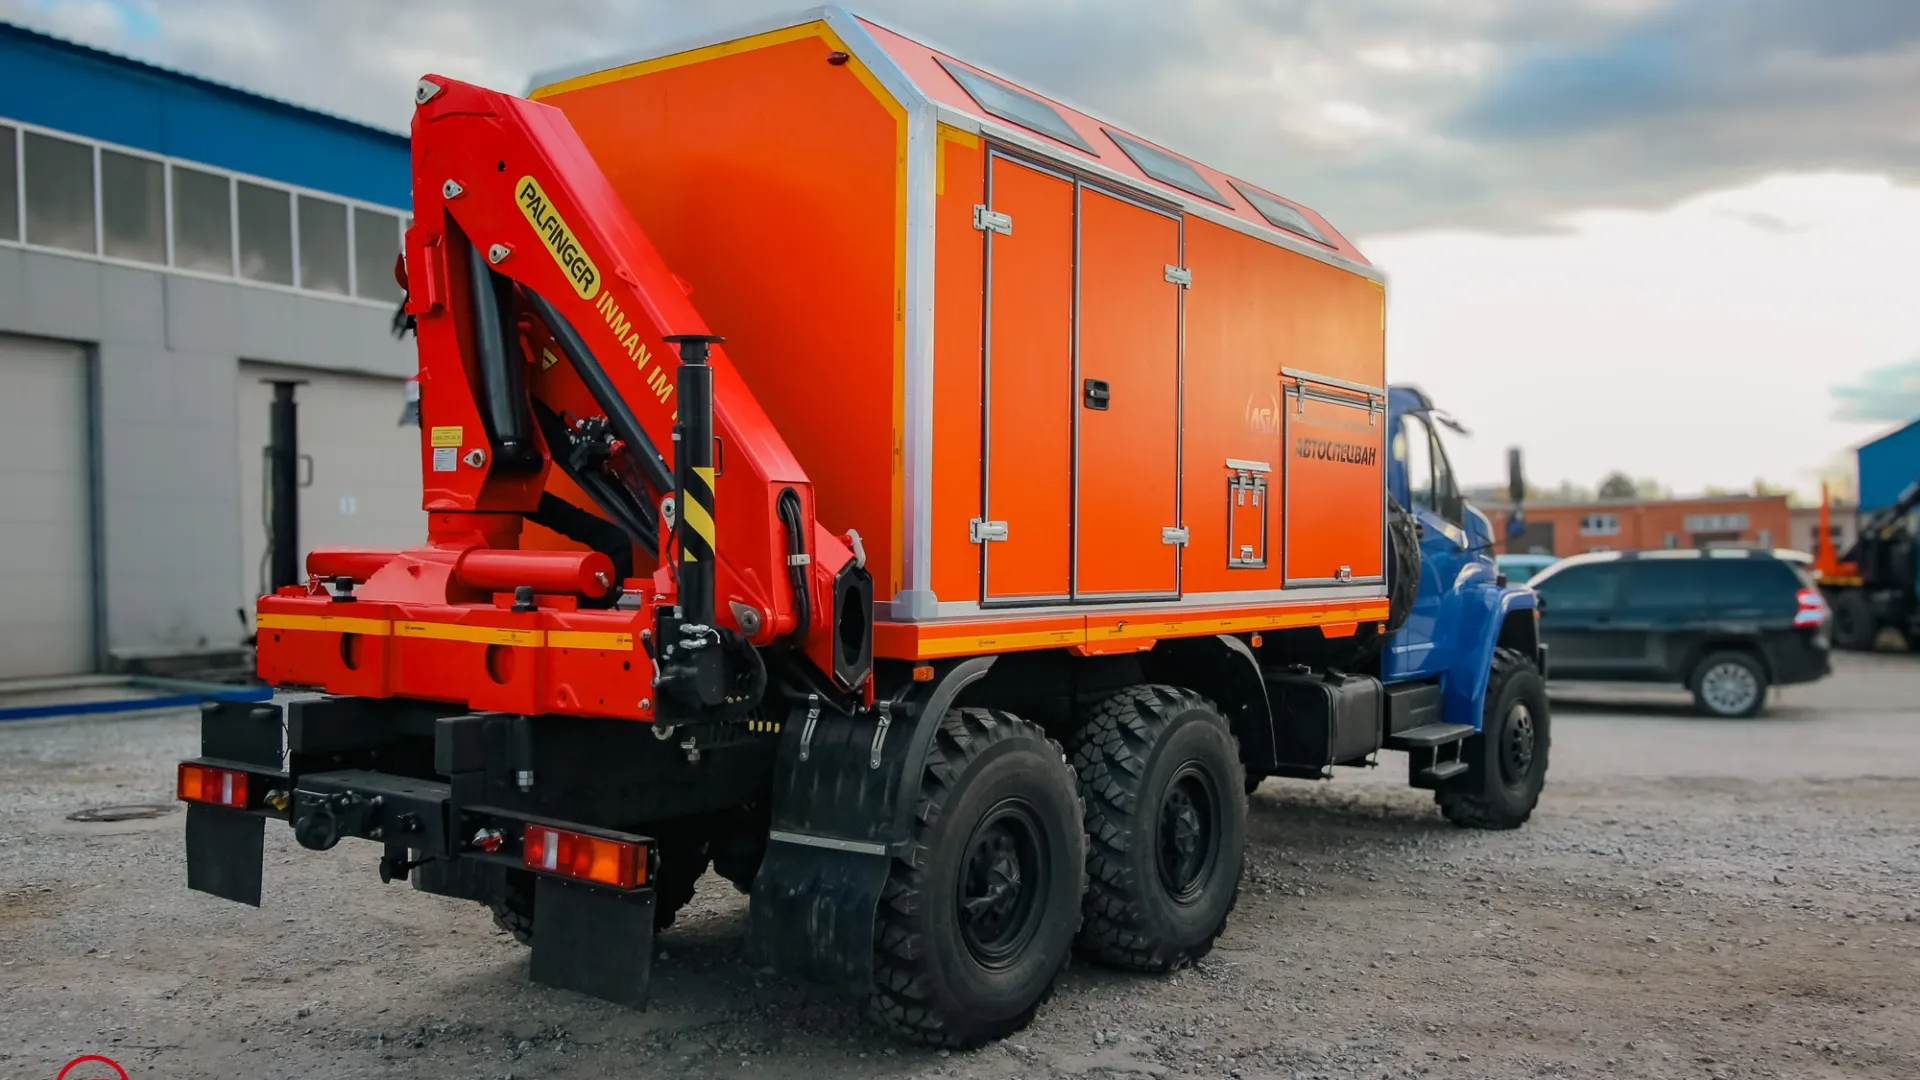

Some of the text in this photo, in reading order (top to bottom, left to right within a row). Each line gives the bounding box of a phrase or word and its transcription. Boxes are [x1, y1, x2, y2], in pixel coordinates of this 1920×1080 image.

[519, 181, 595, 293] PALFINGER
[595, 290, 674, 405] INMAN IM
[1295, 438, 1377, 466] АВТОСПЕЦВАН
